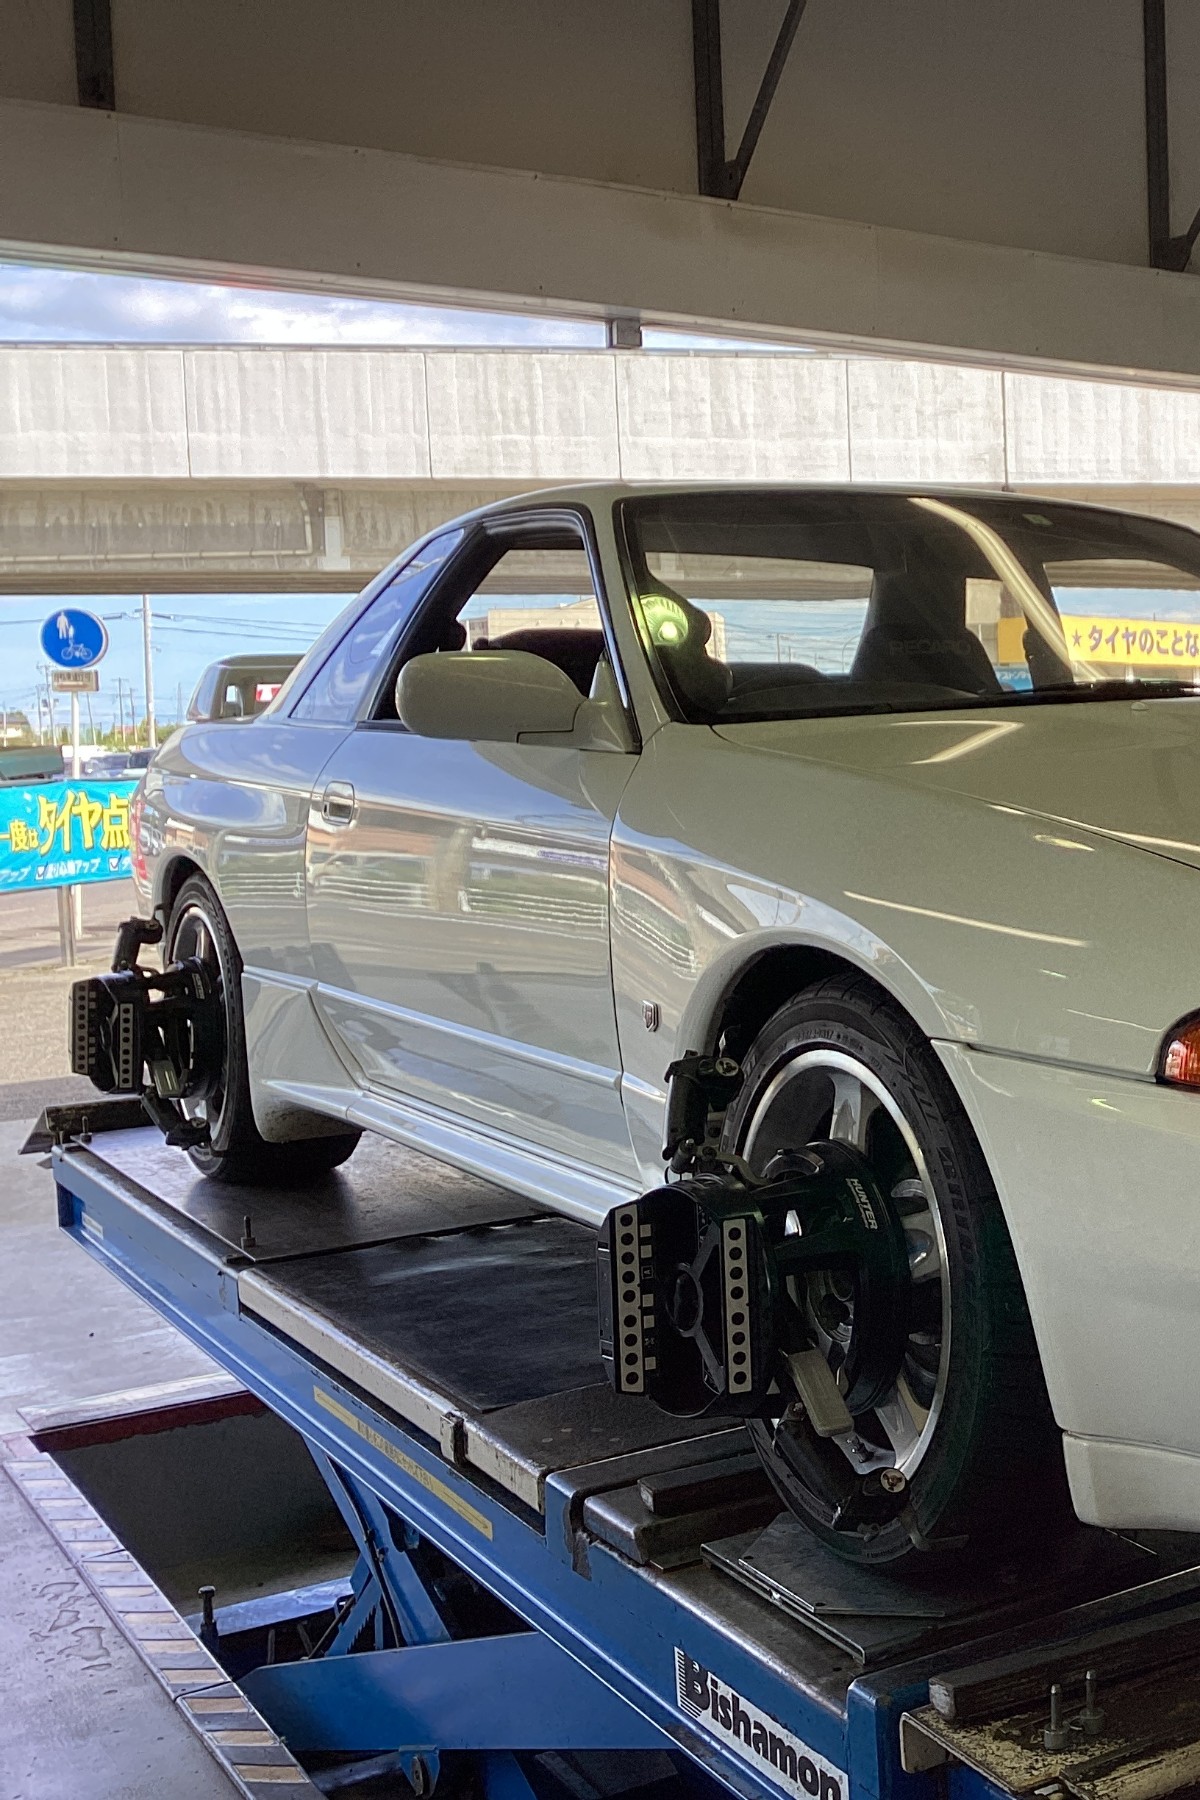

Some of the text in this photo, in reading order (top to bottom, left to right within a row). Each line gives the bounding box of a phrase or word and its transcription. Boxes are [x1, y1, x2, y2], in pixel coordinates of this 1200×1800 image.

[0, 789, 133, 858] 一度はタイヤ点
[850, 1178, 878, 1230] HUNTER
[675, 1649, 842, 1800] Bishamon
